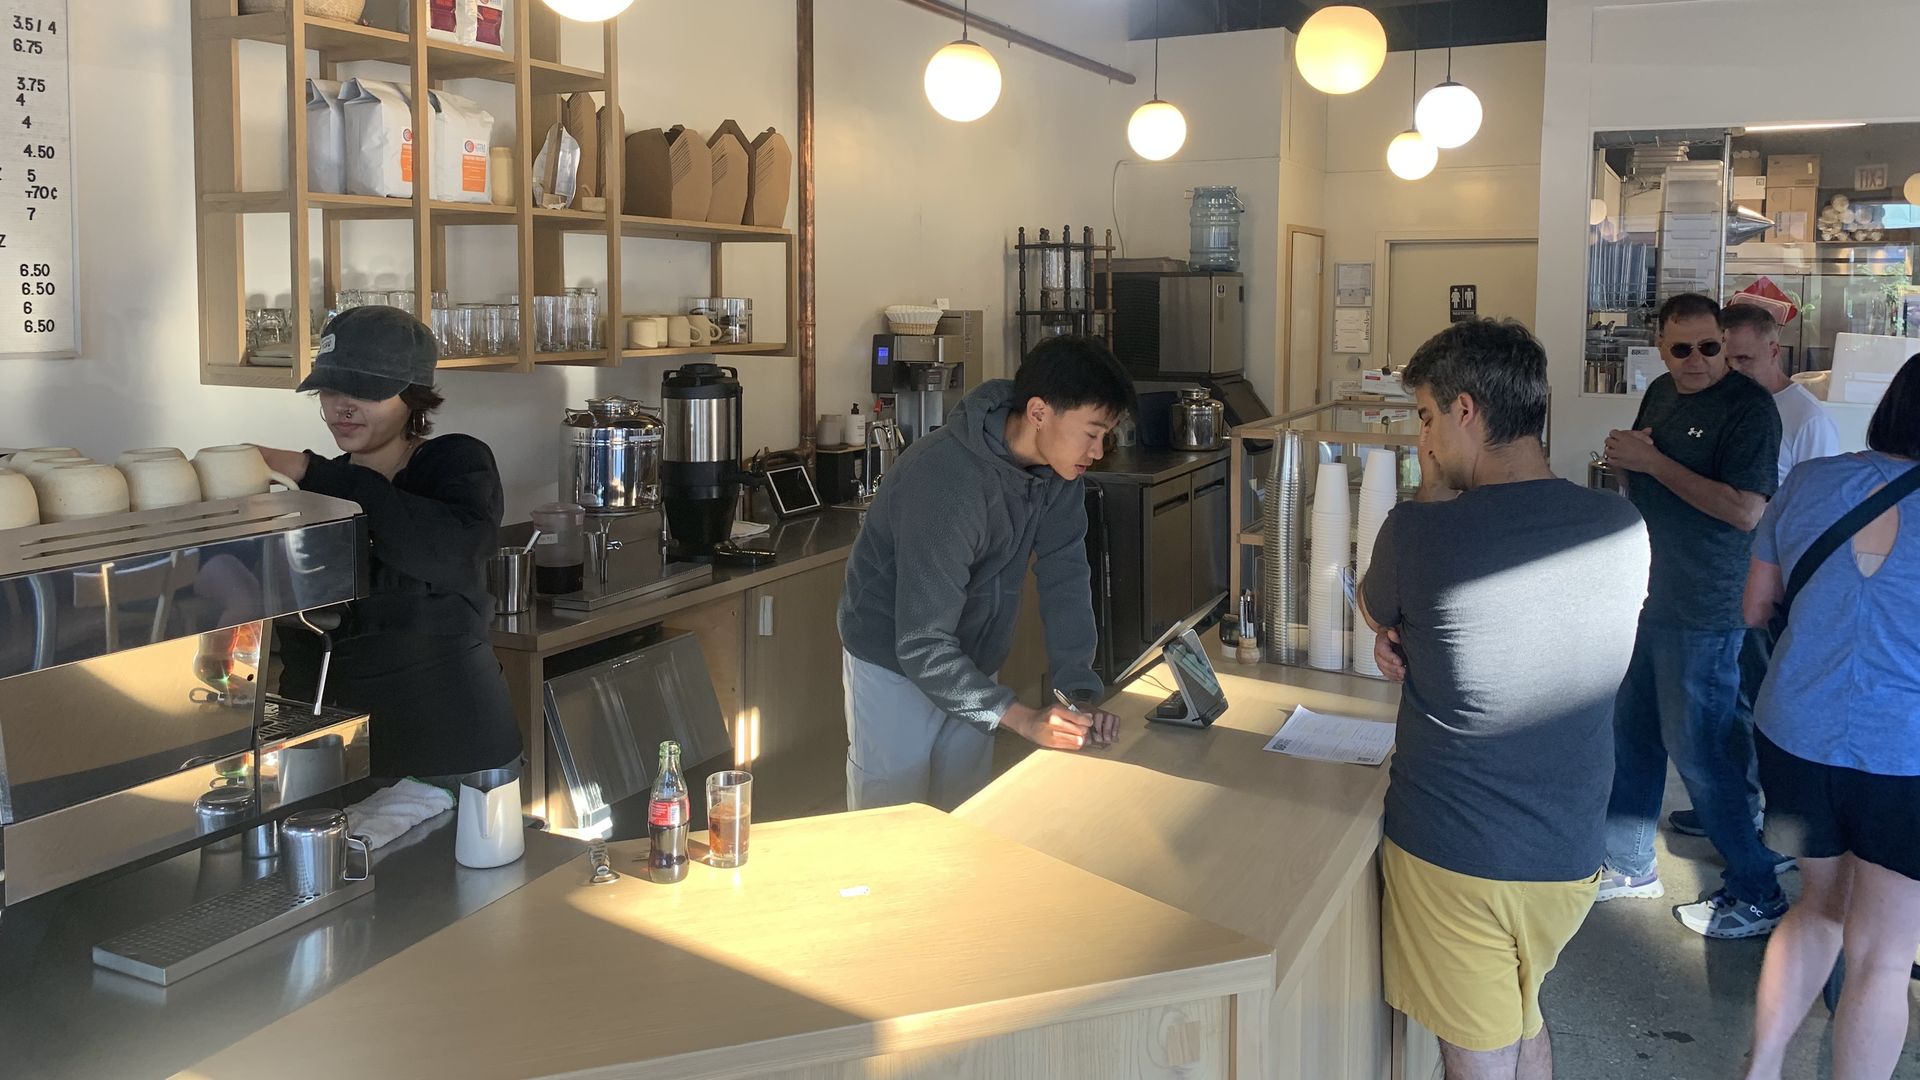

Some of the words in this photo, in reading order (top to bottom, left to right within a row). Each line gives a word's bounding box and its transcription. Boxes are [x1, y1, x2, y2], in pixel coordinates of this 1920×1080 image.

[13, 38, 43, 54] 6.75
[17, 76, 46, 93] 3.75
[16, 93, 26, 106] 4
[22, 116, 32, 129] 4
[23, 144, 55, 159] 4.50
[27, 169, 36, 182] 5
[27, 207, 36, 220] 7
[20, 264, 50, 277] 6.50
[22, 282, 55, 295] 6.50
[23, 301, 32, 314] 6
[24, 319, 55, 333] 6.50
